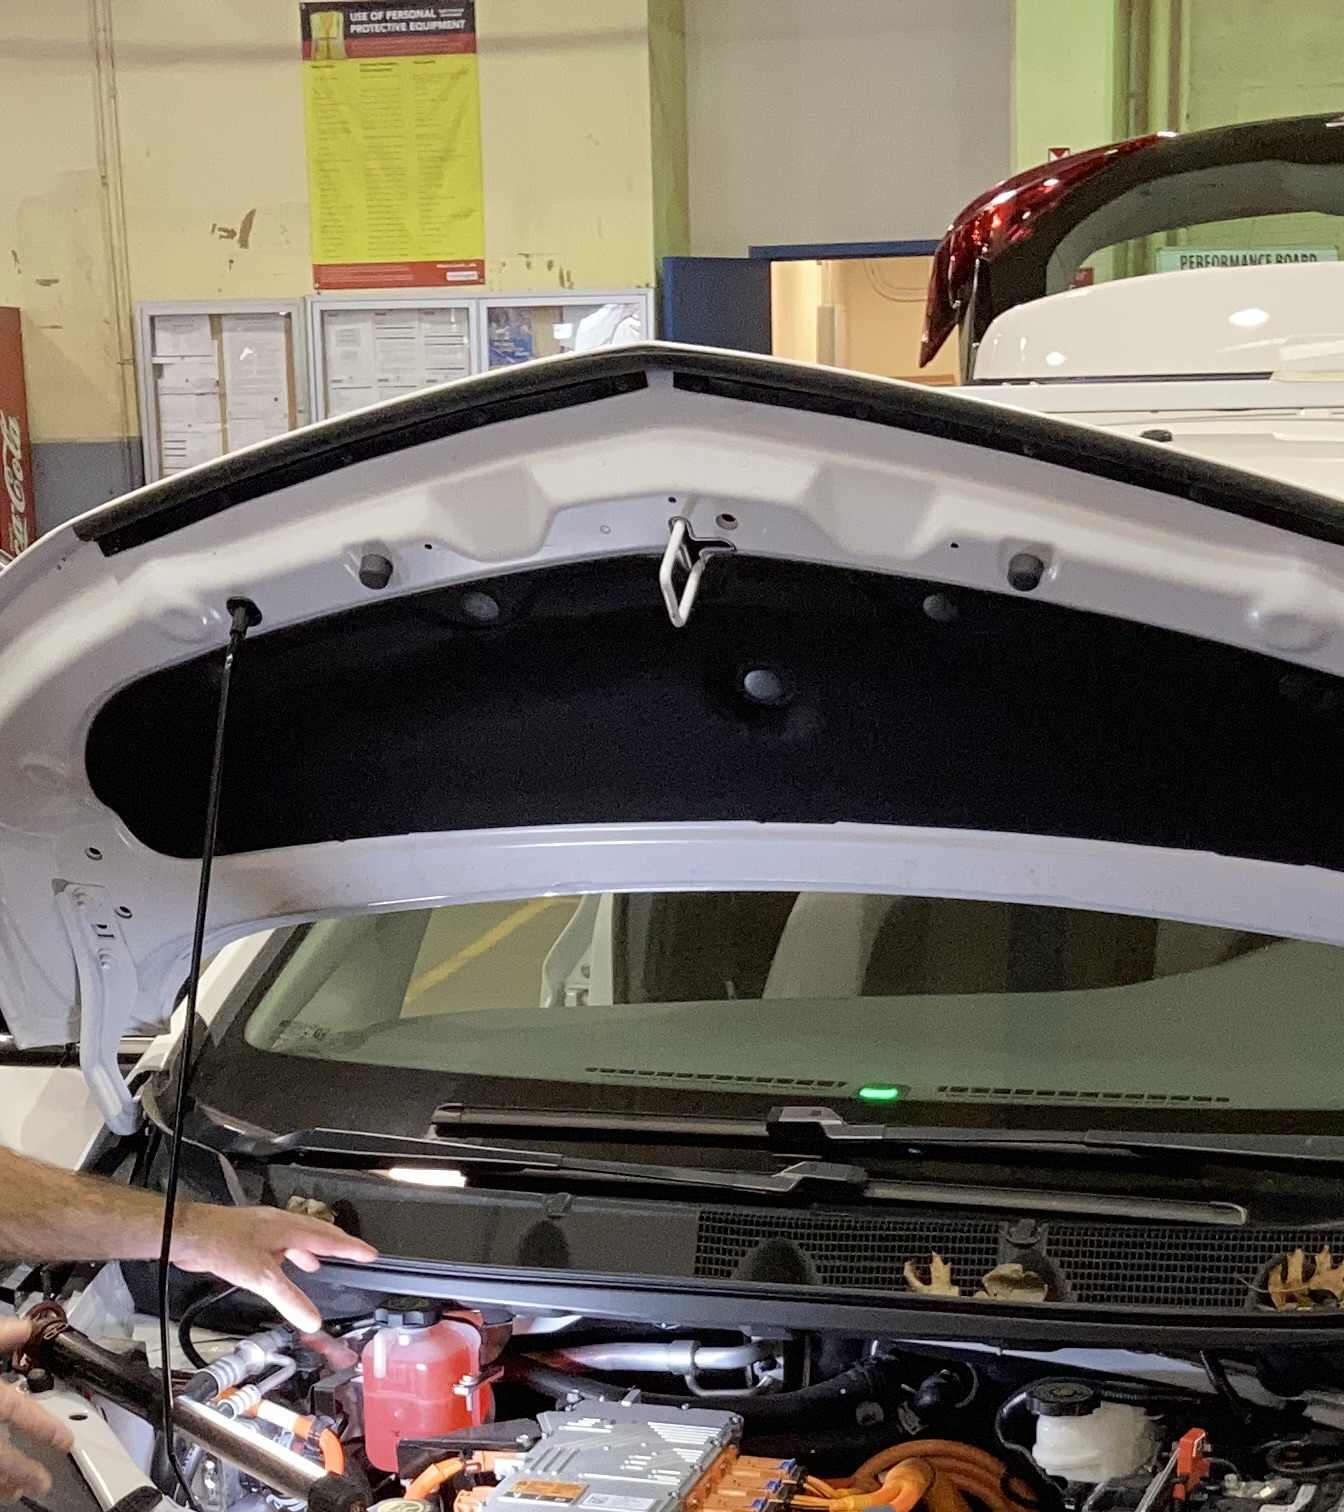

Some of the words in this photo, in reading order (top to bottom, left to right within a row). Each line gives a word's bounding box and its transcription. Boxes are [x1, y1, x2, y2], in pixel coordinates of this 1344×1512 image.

[349, 12, 368, 22] USE
[370, 11, 384, 21] OF
[385, 9, 437, 21] PERSONAL
[349, 22, 407, 33] PROTECTIVE
[409, 20, 466, 31] EQUIPMENT
[1179, 254, 1272, 270] PERFORMANCE
